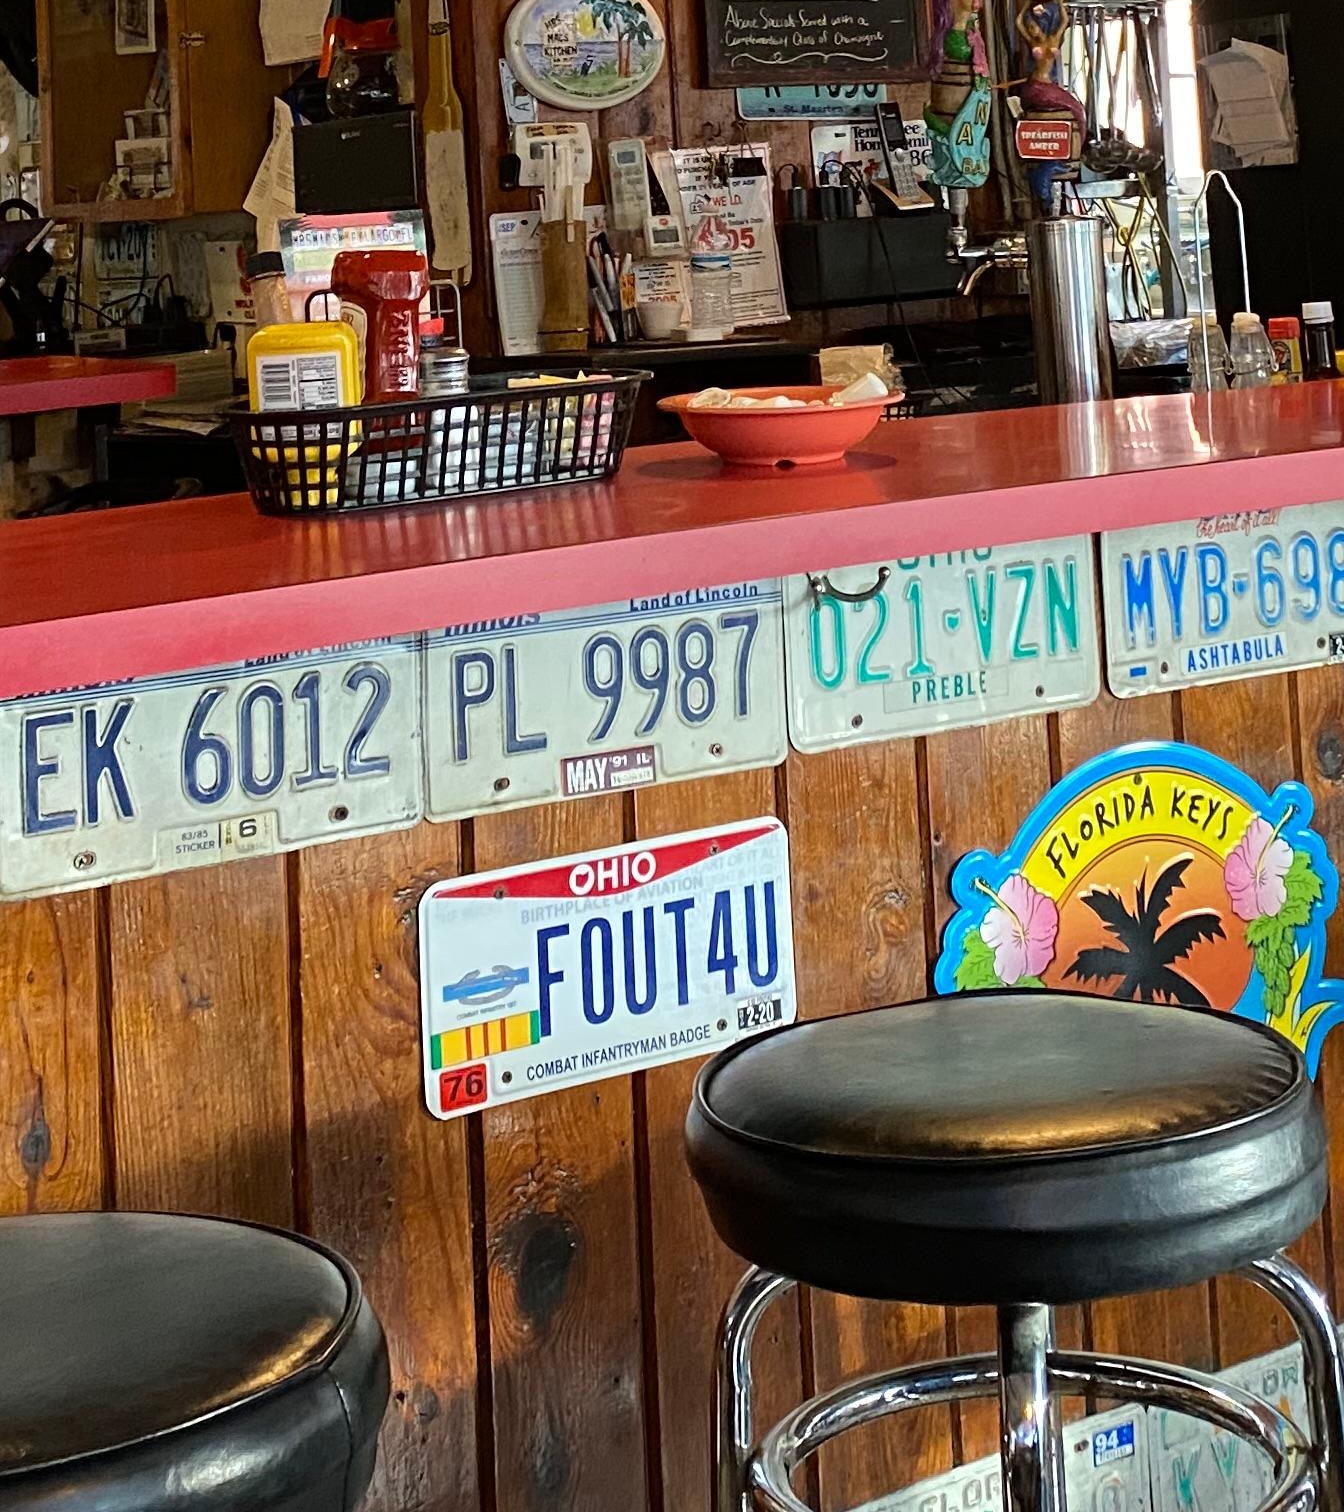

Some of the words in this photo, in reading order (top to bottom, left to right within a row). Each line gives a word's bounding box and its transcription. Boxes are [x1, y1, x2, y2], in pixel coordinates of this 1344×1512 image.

[544, 45, 578, 57] KITCHEN
[630, 594, 665, 613] Land
[666, 591, 690, 608] of
[693, 582, 760, 604] Lincoln
[966, 560, 1080, 668] VZN
[1122, 542, 1230, 651] MYB
[1186, 633, 1286, 674] ASHTABULA
[454, 648, 549, 766] PL
[582, 612, 761, 745] 9987
[911, 673, 989, 705] PREBLE
[22, 698, 137, 838] EK
[181, 664, 392, 806] 6012
[567, 759, 608, 796] MAY
[174, 840, 216, 856] STICKER
[180, 829, 209, 843] 83/85
[1045, 784, 1156, 880] FLORIDA
[1170, 787, 1236, 841] KEYS
[569, 851, 657, 896] OHIO
[637, 875, 704, 903] AVIATION
[537, 880, 780, 1039] FOUT4U
[744, 1000, 776, 1025] 2-20
[526, 1053, 579, 1082] COMBAT
[580, 1036, 668, 1070] INFANTRYMAN
[669, 1023, 712, 1050] BADGE
[443, 1070, 484, 1104] 76
[1093, 1429, 1120, 1455] 94
